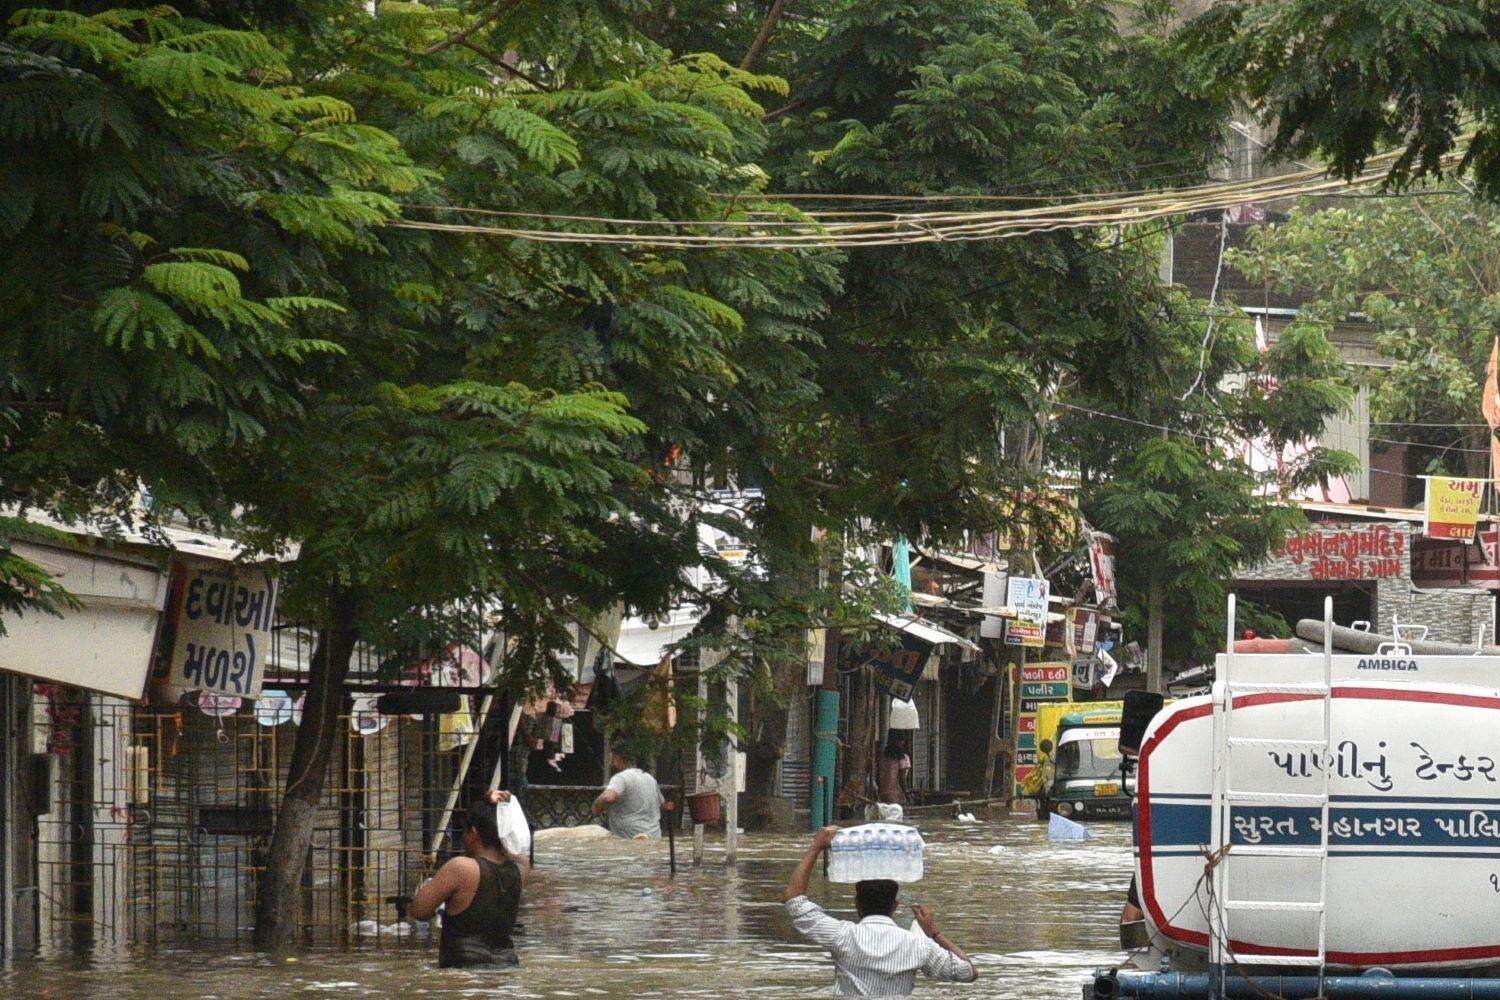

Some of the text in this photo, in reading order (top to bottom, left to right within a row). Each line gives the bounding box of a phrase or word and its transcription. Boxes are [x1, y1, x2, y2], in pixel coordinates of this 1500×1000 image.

[1275, 531, 1359, 565] નુમાનજી
[1357, 659, 1418, 671] AMBICA
[1027, 683, 1054, 695] પનીર
[1268, 740, 1496, 791] પાણીનું ટેન્કર
[1234, 815, 1298, 843] સુરત
